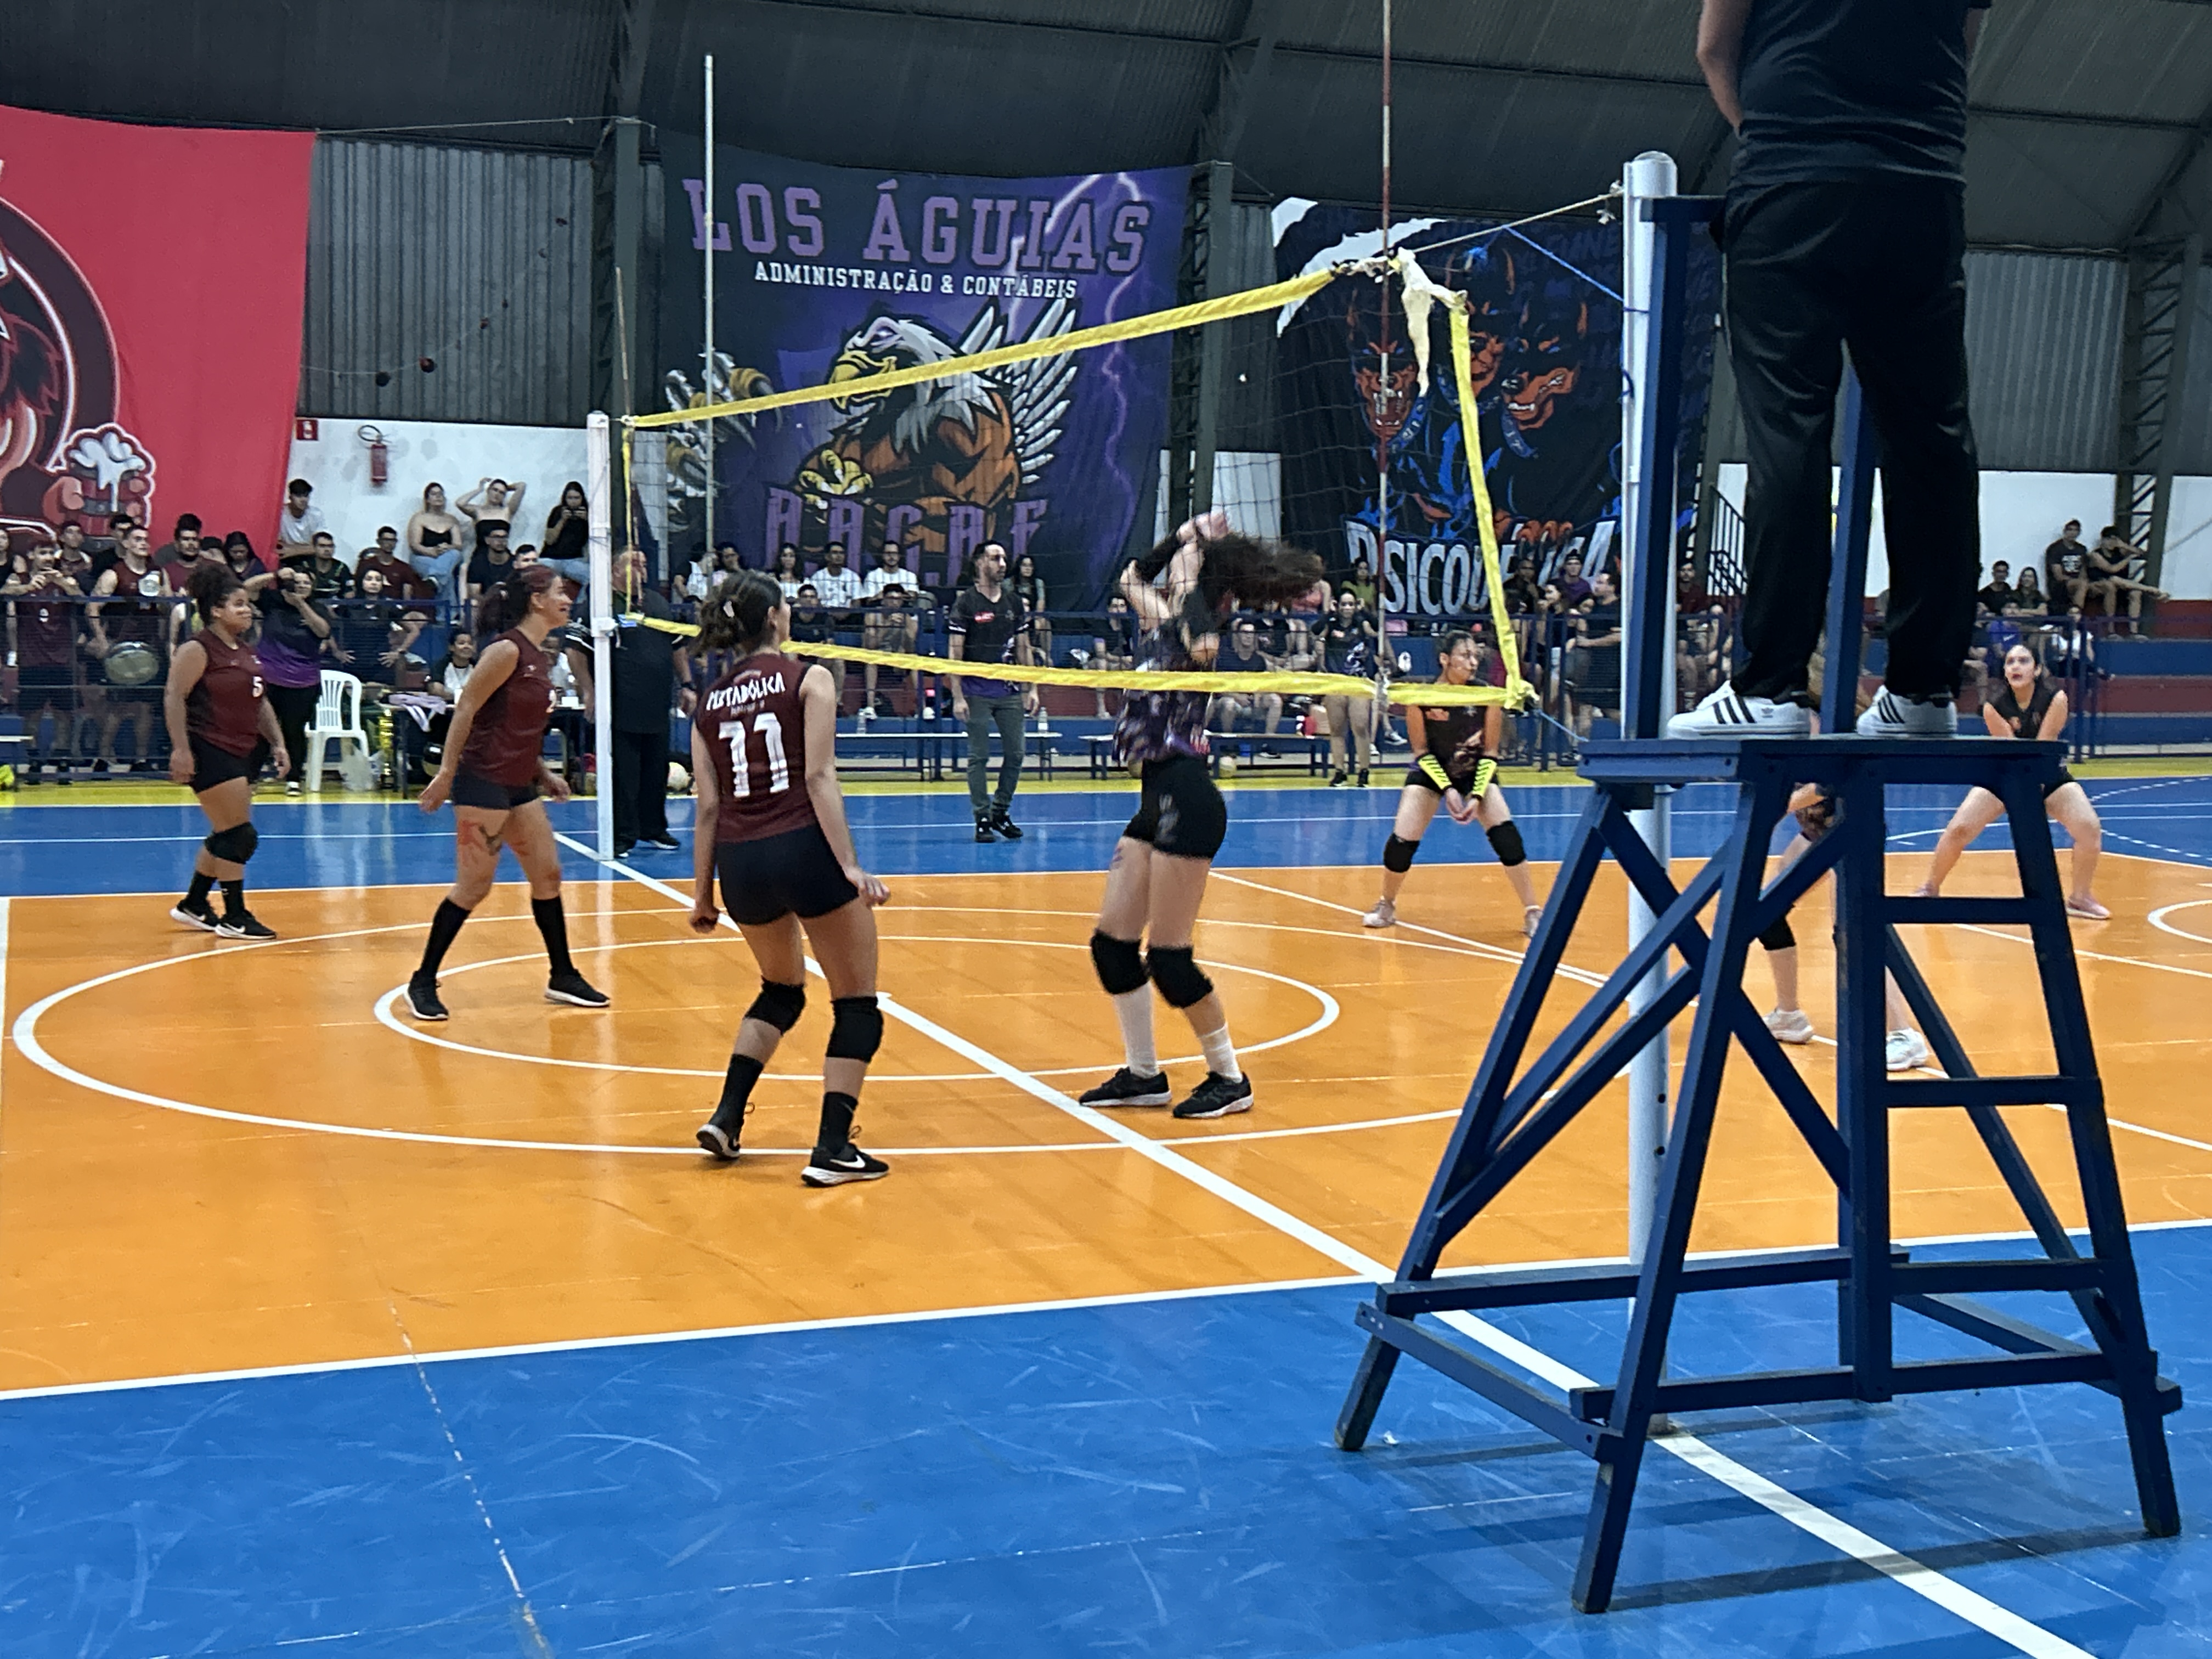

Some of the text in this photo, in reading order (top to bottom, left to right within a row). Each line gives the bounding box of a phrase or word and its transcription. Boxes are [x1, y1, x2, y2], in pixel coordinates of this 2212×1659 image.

[682, 178, 1152, 274] LOS ÁGUIAS
[754, 261, 1077, 300] ADMINISTRAÇÃO & CONTÁBEIS
